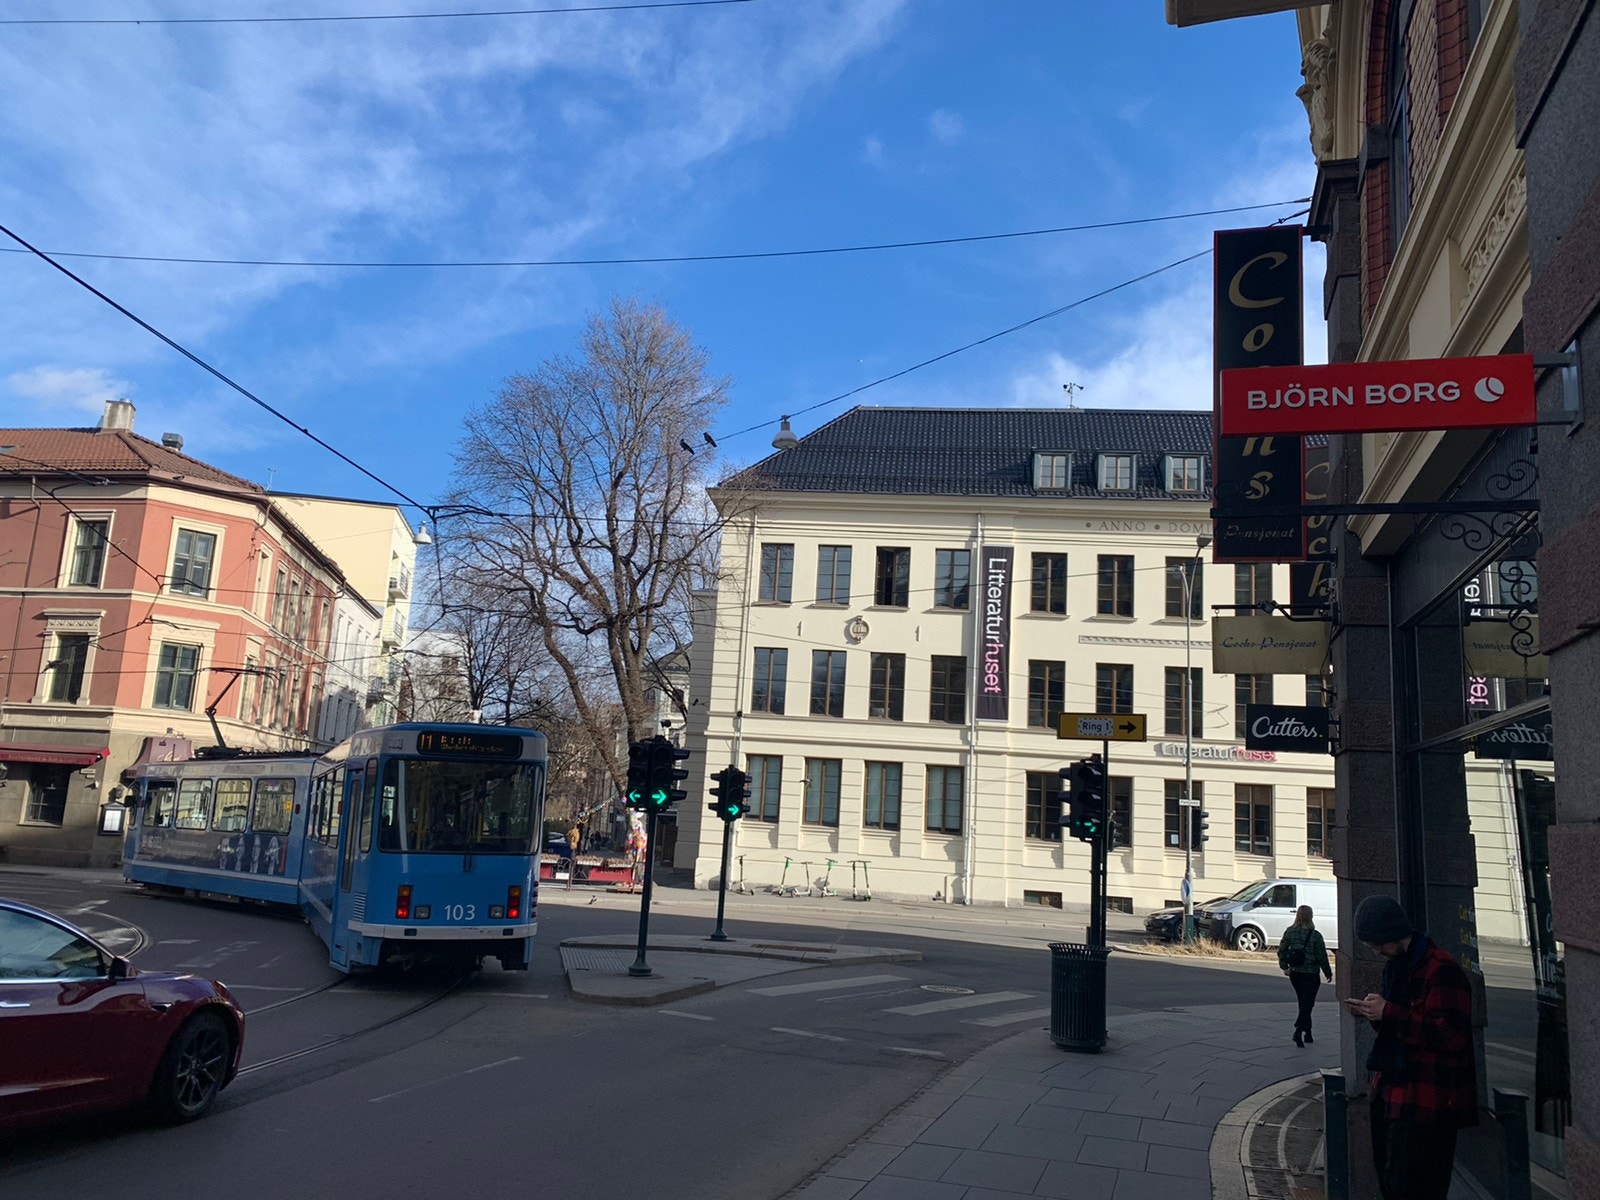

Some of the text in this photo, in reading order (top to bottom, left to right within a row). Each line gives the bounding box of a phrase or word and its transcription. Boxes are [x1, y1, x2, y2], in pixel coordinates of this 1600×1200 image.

[1228, 251, 1288, 499] Cos
[1247, 381, 1461, 410] BJÖRN BORG
[1099, 520, 1211, 533] ANNO DOMI
[984, 557, 1008, 694] Litteraturhuset
[1082, 721, 1109, 732] Ring 1
[444, 904, 476, 921] 103
